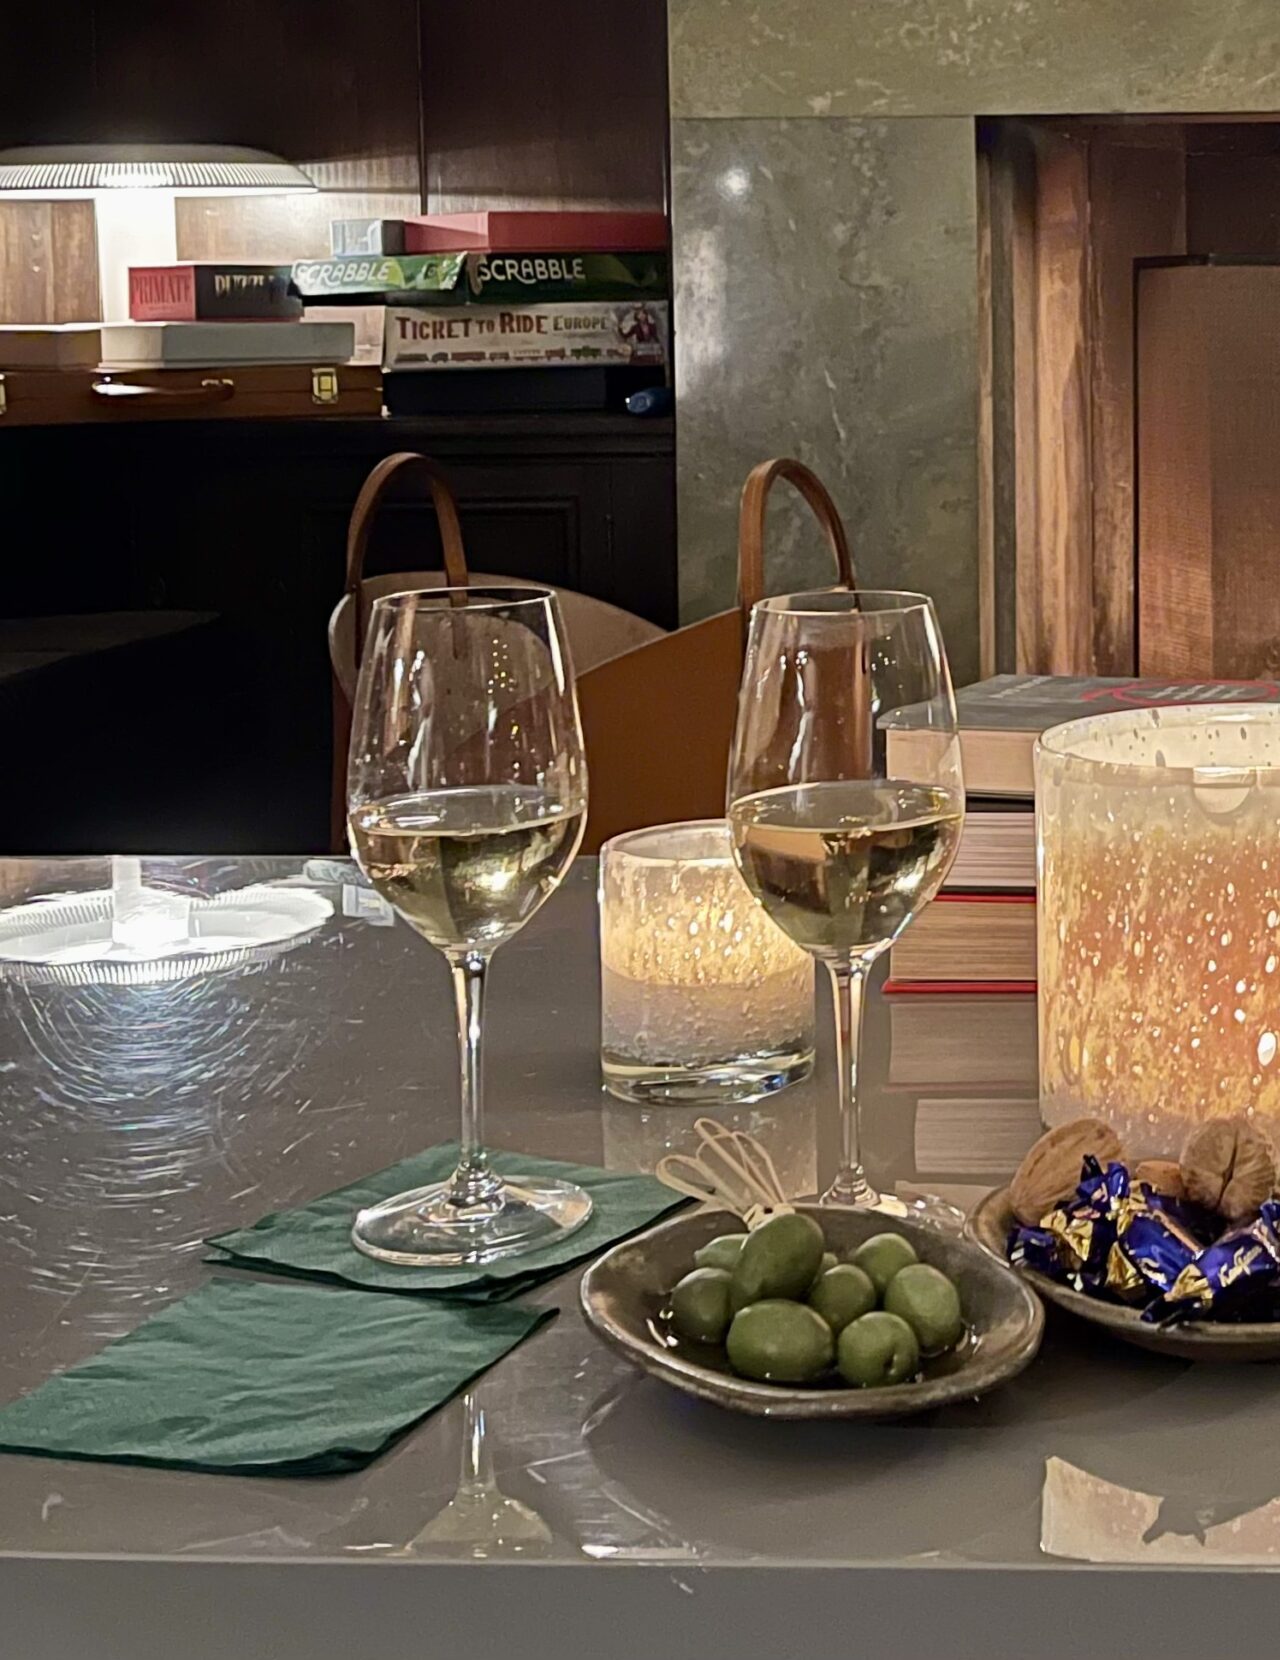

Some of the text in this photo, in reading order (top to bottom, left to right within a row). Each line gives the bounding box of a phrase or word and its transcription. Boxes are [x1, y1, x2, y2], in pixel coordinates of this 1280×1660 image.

[297, 261, 390, 287] SCRABBLE
[480, 258, 585, 284] SCRABBLE
[395, 316, 472, 340] TICKET
[499, 312, 548, 335] RIDE
[552, 314, 607, 331] EUROPE
